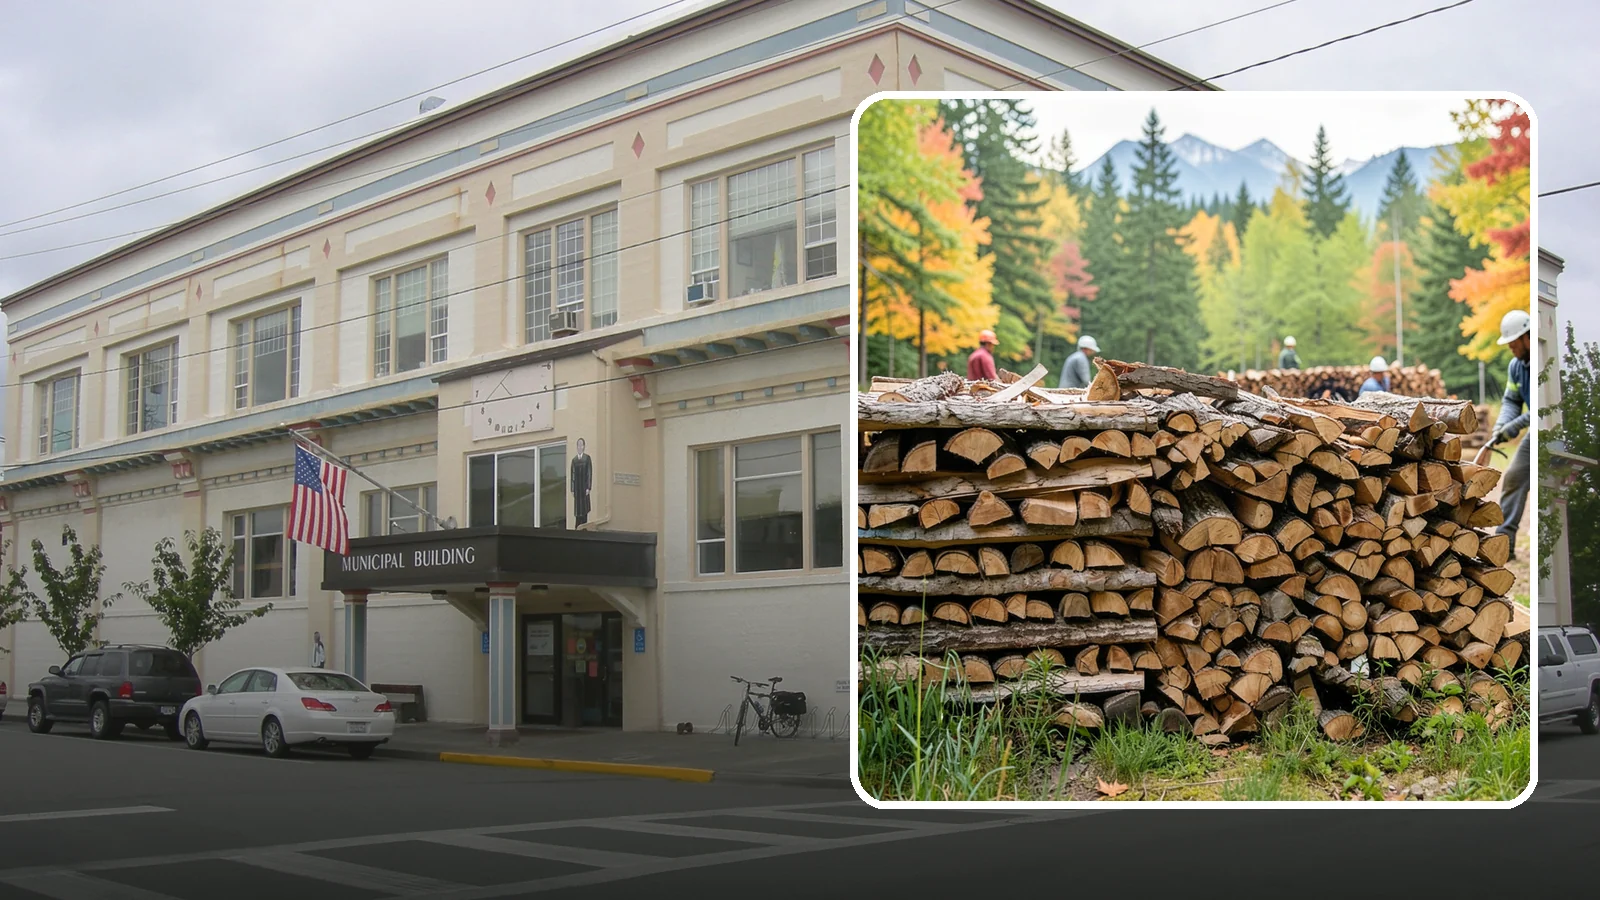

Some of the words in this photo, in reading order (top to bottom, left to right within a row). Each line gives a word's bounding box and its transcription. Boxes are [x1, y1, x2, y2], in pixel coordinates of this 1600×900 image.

[480, 406, 485, 415] 8
[535, 402, 540, 410] 4
[487, 417, 493, 426] 9
[528, 413, 533, 422] 3
[494, 423, 500, 432] 10
[520, 420, 526, 428] 2
[507, 425, 514, 433] 12
[342, 552, 405, 572] MUNICIPAL
[414, 546, 475, 567] BUILDING
